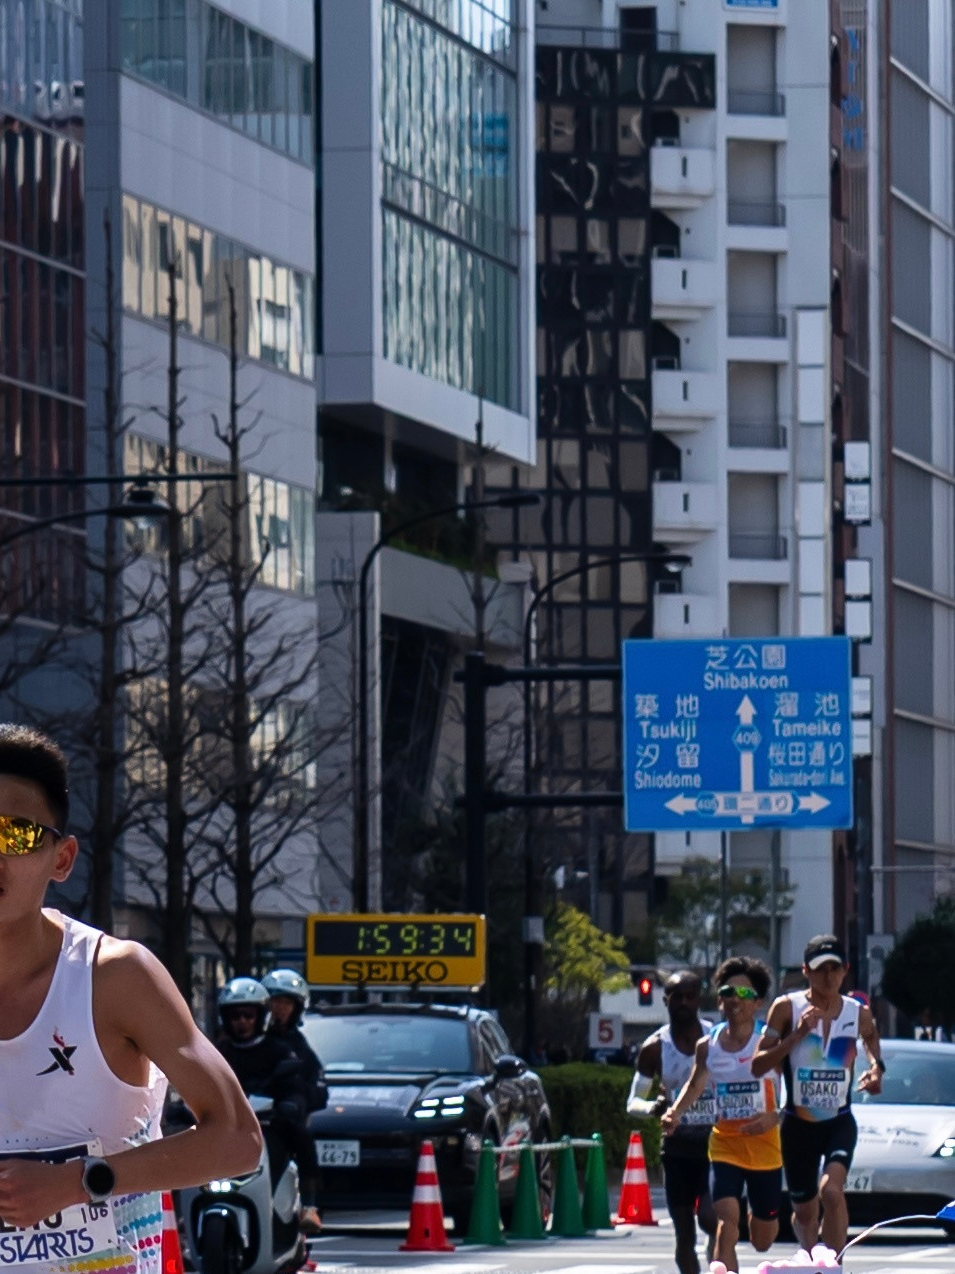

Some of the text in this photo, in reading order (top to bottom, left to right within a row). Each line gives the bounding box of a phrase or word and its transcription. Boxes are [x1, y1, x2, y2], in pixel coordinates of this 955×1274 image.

[705, 645, 786, 670] 芝公園
[704, 672, 788, 690] Shibakoen
[635, 694, 699, 718] 築地
[775, 692, 840, 717] 溜池
[641, 721, 696, 742] Tsukiji
[773, 719, 841, 737] Tameike
[636, 744, 700, 769] 汐留
[769, 741, 844, 766] 桜田通り
[635, 771, 701, 789] Shiodome
[357, 925, 472, 954] 1:59:34
[341, 960, 448, 983] SEIKO
[598, 1019, 614, 1043] 5
[800, 1082, 838, 1097] OSAKO
